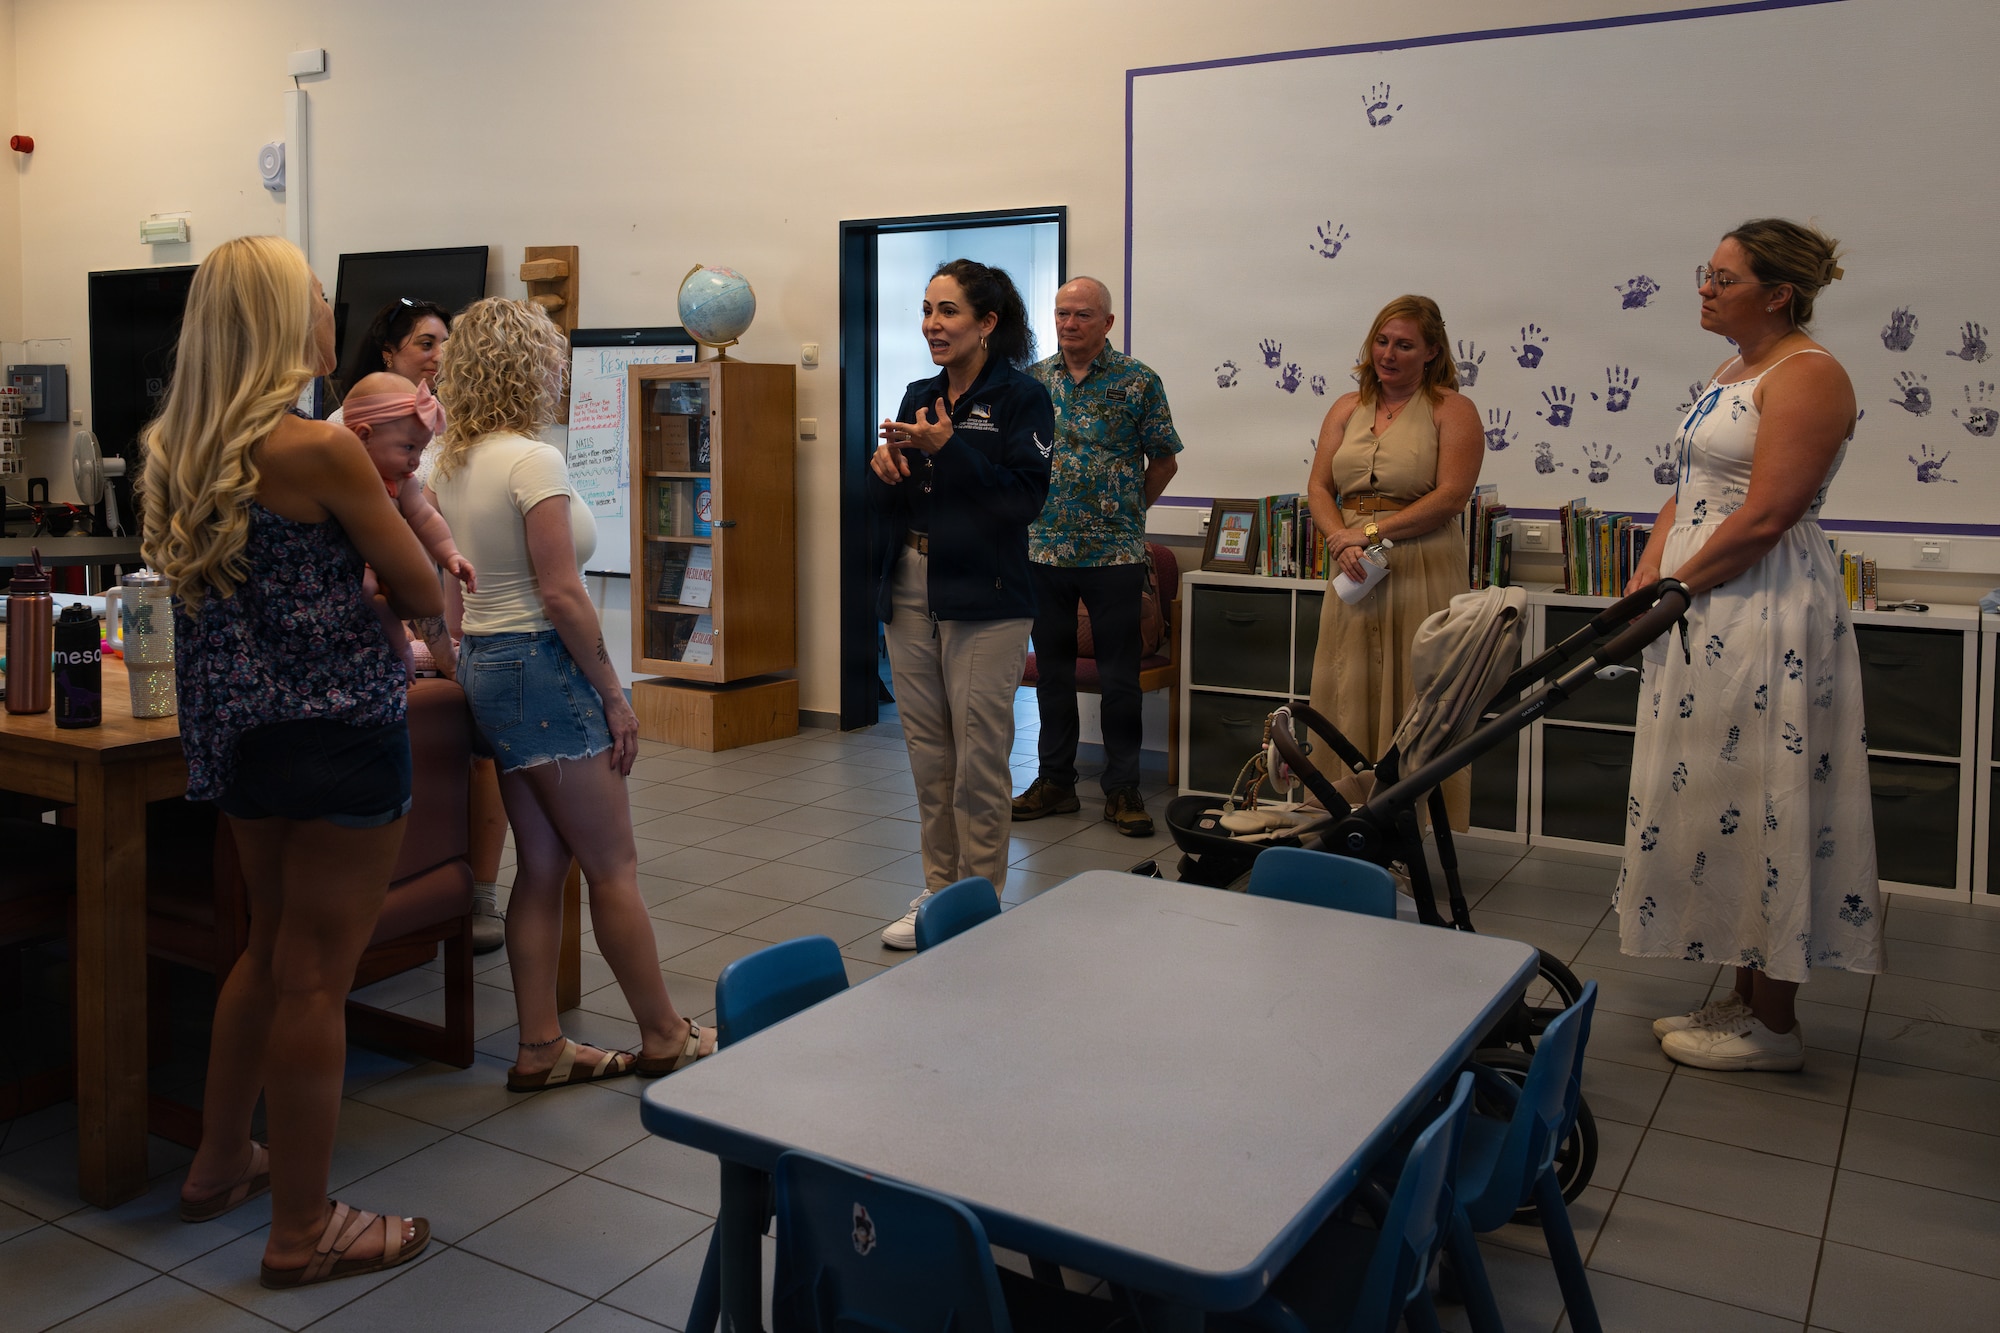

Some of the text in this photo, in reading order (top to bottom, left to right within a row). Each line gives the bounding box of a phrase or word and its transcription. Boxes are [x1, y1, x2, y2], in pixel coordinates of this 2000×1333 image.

[576, 436, 594, 448] NAILS
[1226, 531, 1241, 539] FREE
[1221, 546, 1240, 554] BOOKS
[686, 567, 712, 582] RESILIENCE
